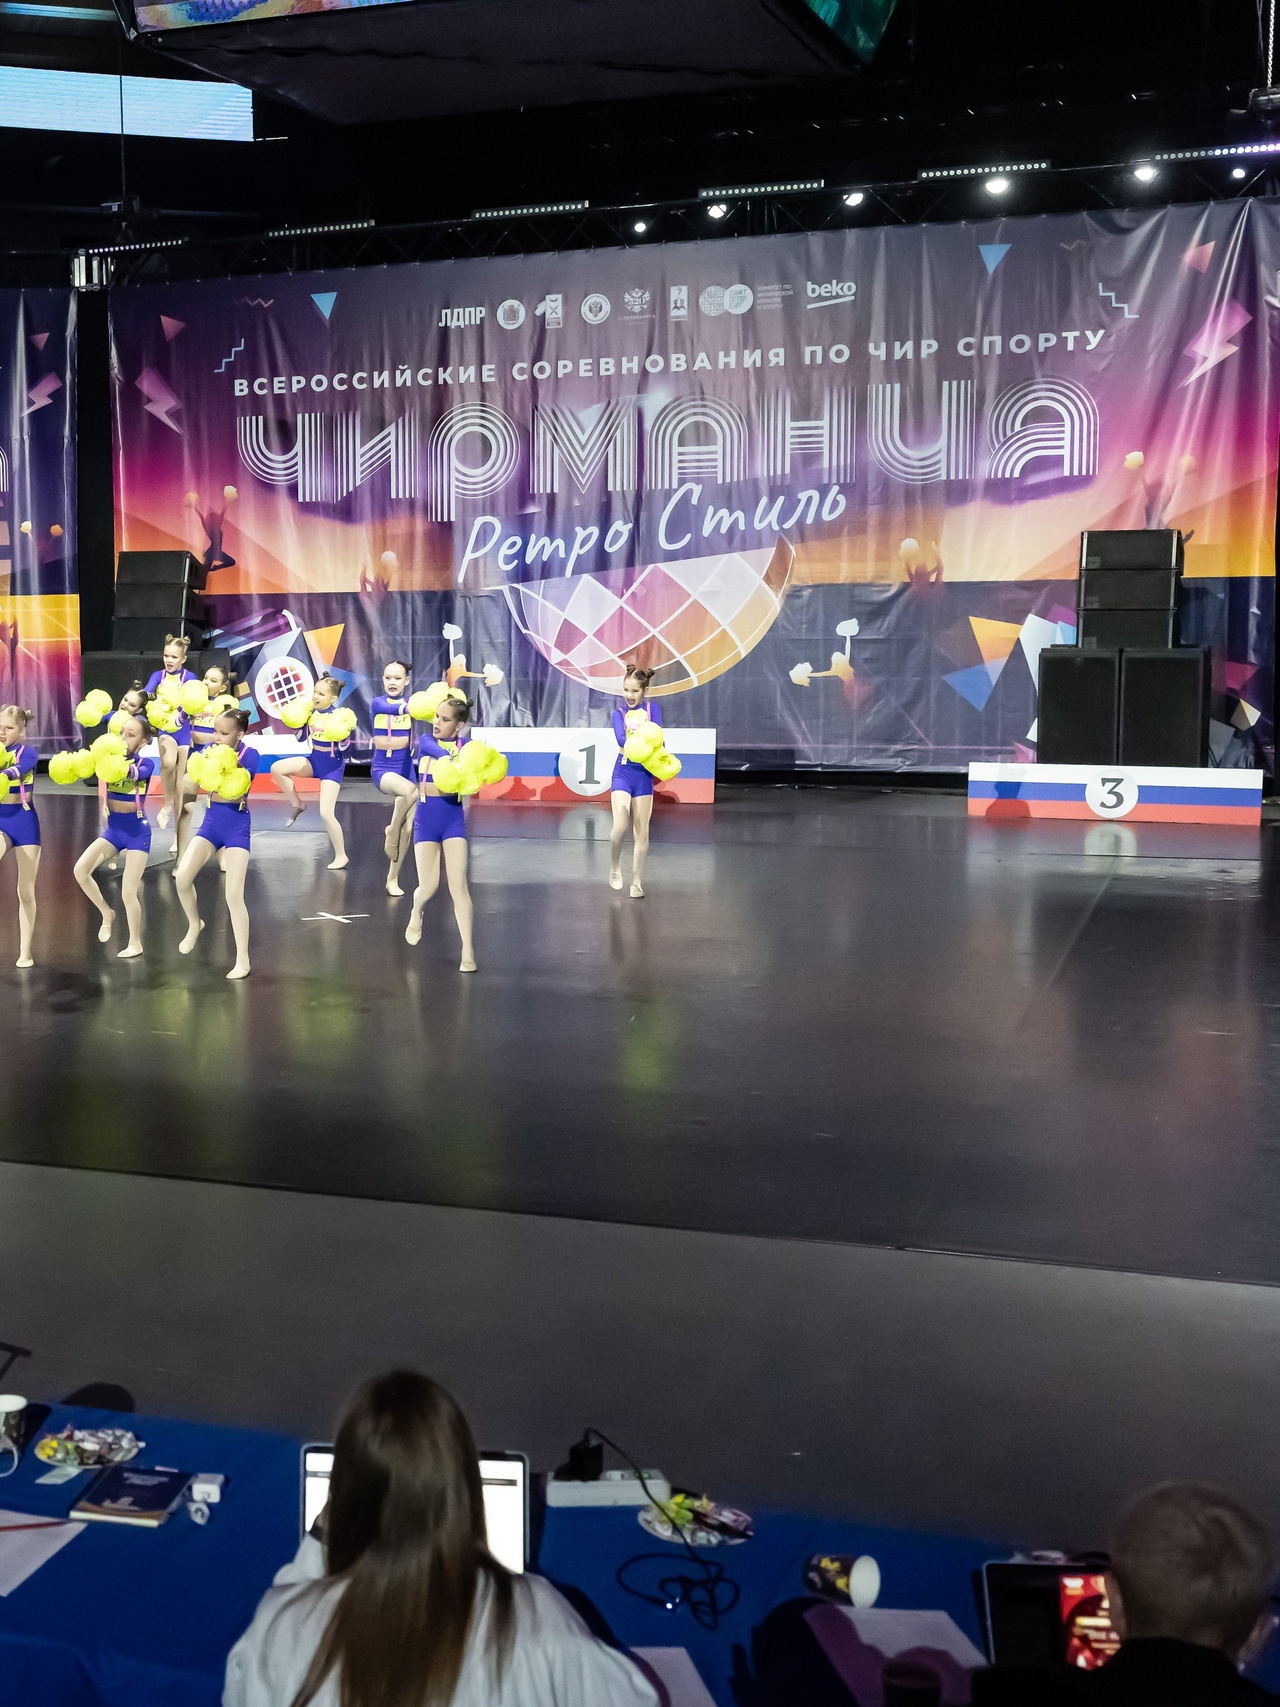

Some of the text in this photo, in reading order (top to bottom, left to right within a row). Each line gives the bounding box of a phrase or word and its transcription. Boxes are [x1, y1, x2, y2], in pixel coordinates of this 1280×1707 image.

[806, 279, 857, 298] beko
[438, 306, 486, 329] ЛДПР
[233, 329, 1106, 397] ВСЕРОССИЙСКИЕ СОРЕВНОВАНИЯ ПО ЧИР СПОРТУ
[457, 482, 848, 584] Ретро Стиль
[578, 744, 601, 785] 1
[1099, 777, 1125, 809] 3
